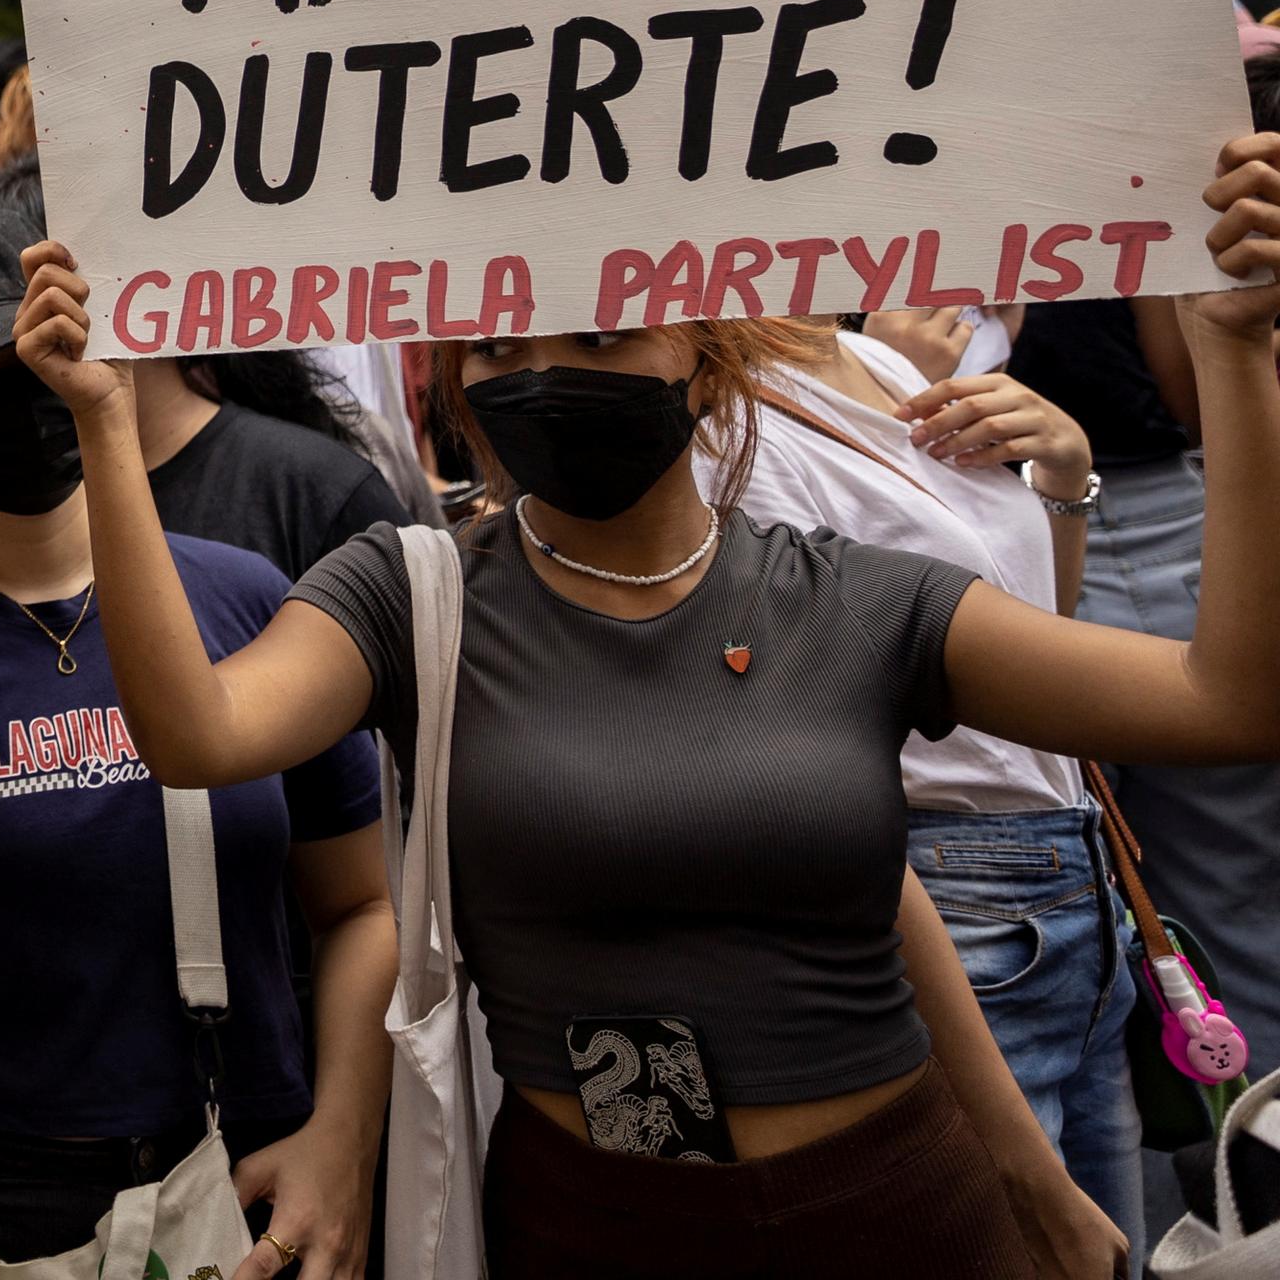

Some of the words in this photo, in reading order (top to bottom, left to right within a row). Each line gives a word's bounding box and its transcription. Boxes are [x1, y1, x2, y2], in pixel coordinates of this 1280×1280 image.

[112, 254, 536, 355] GABRIELA
[594, 220, 1173, 331] PARTYLIST
[76, 756, 151, 788] Beac
